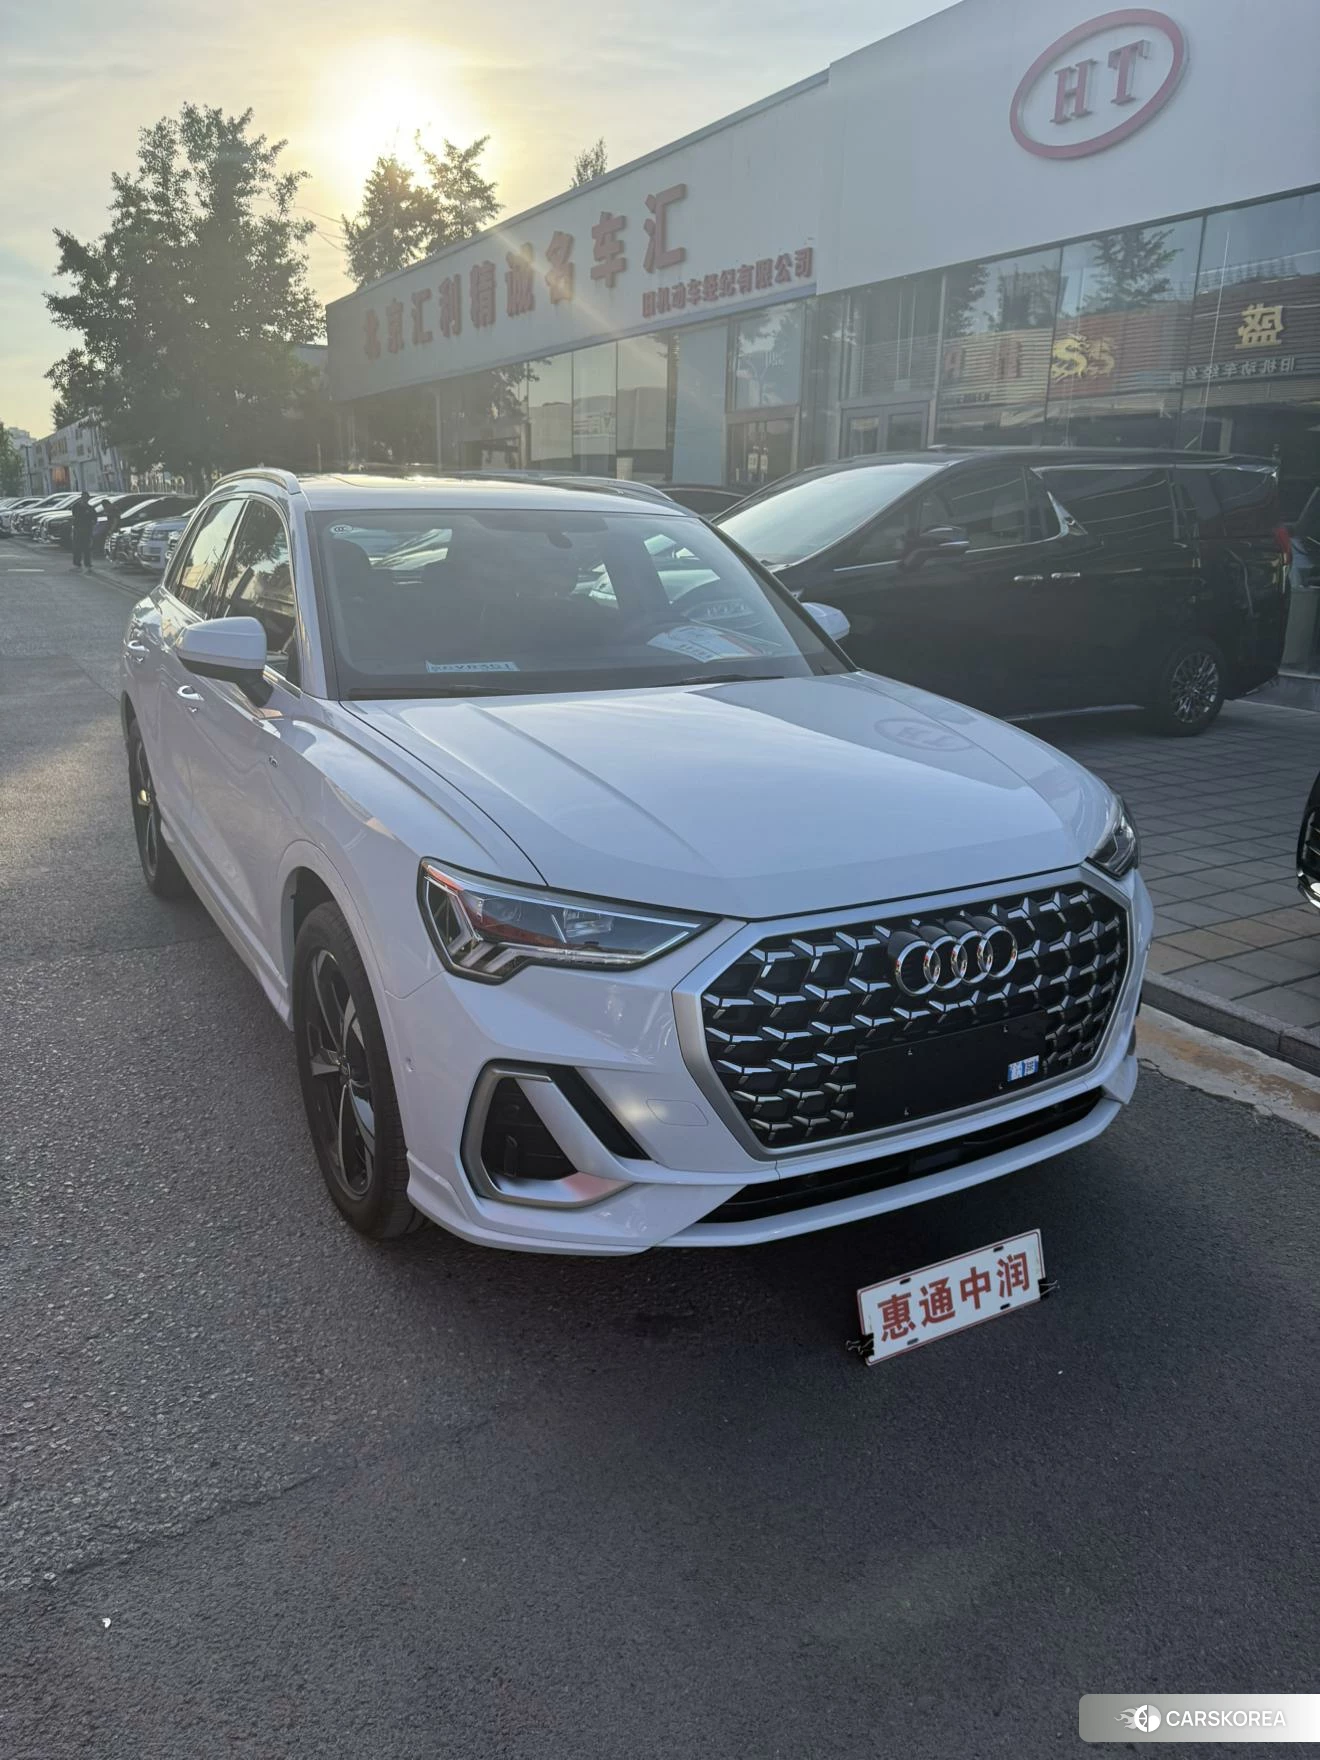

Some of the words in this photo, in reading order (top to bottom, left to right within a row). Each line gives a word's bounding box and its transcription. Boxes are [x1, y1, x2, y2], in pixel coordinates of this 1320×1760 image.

[1049, 39, 1152, 124] HT
[877, 1252, 1030, 1342] 惠通中润
